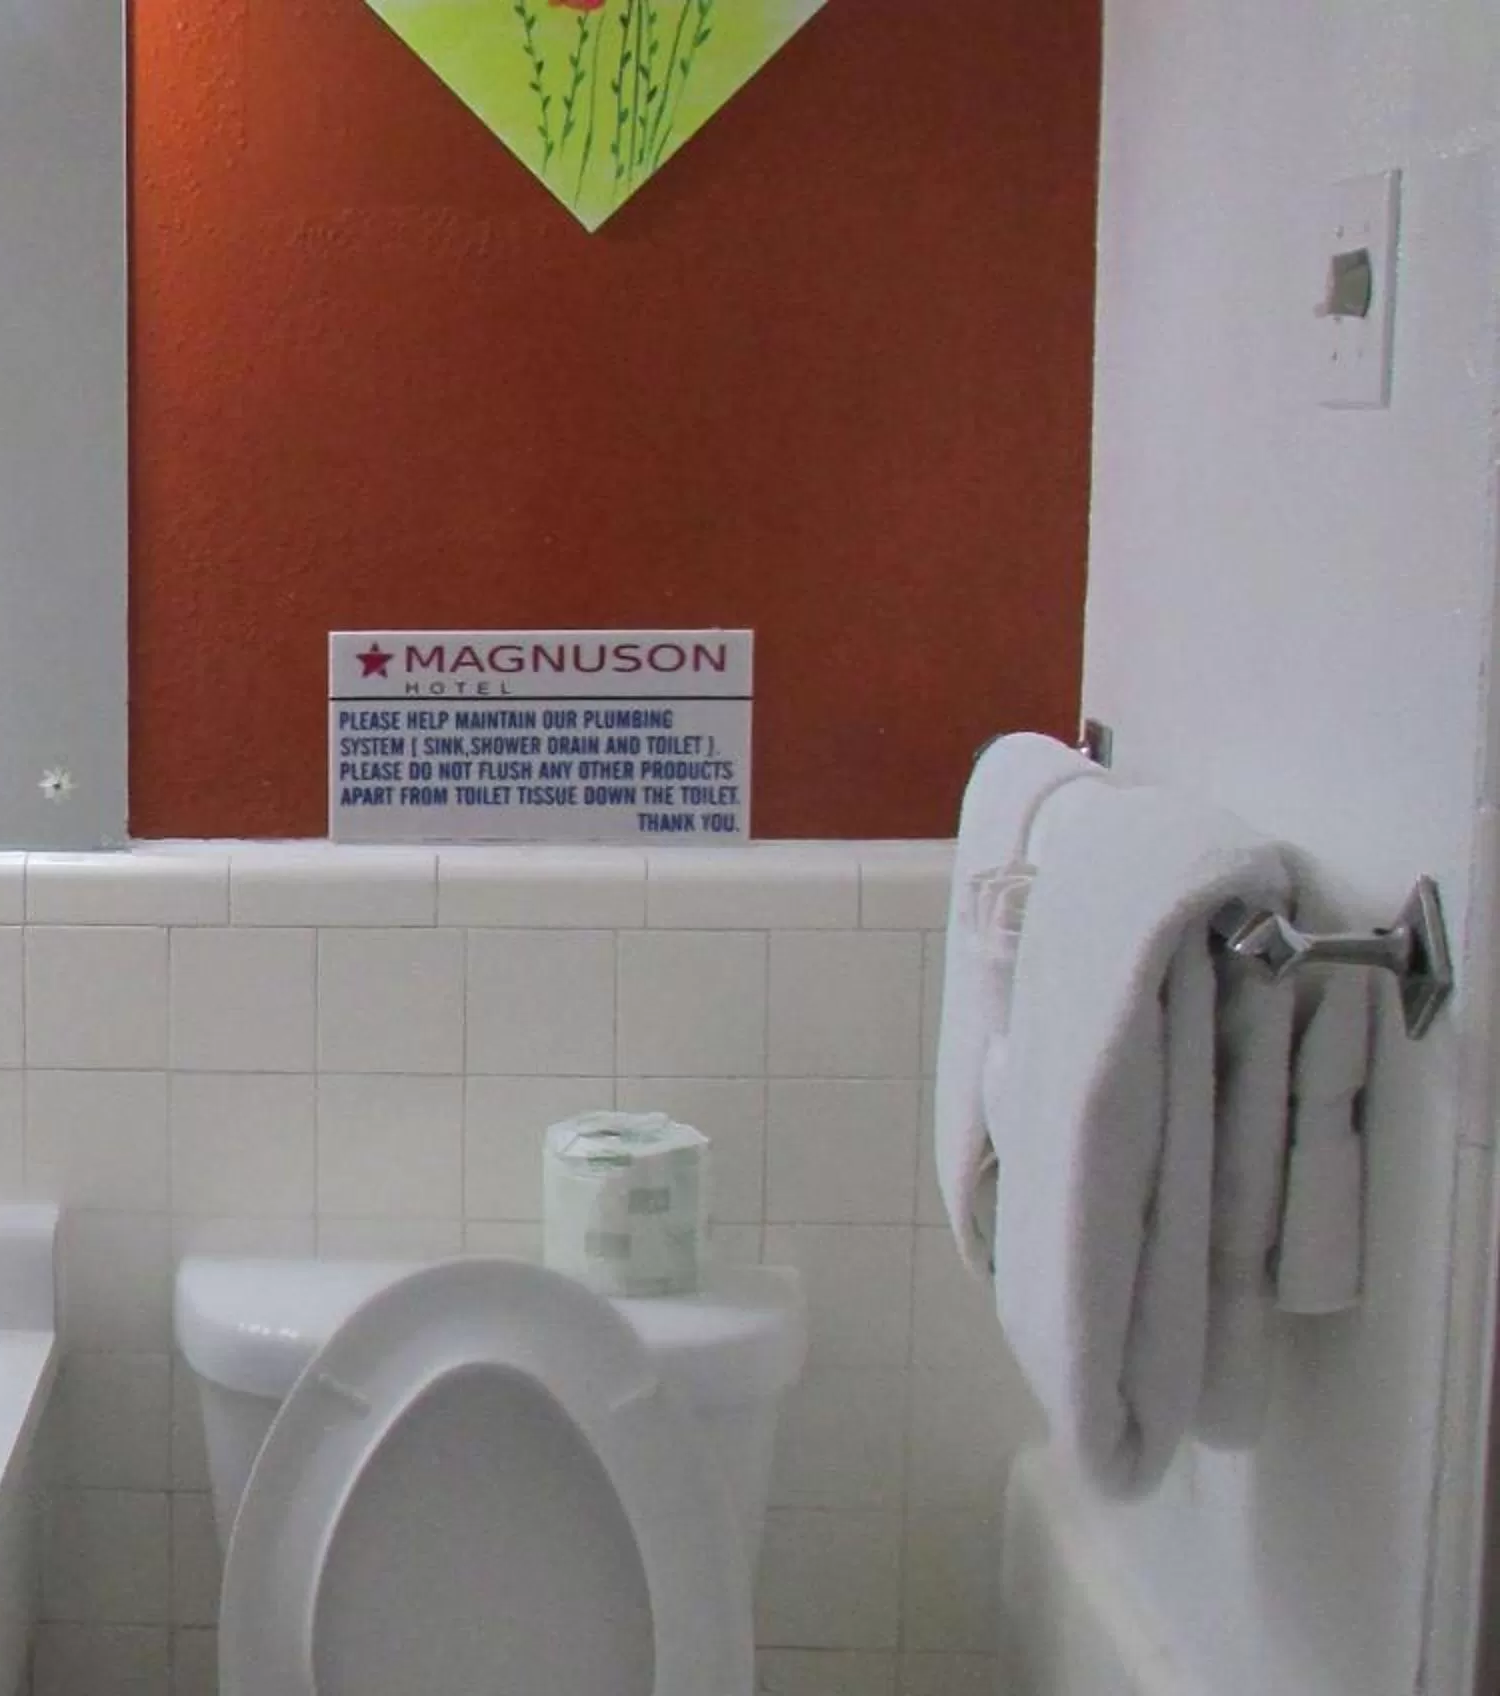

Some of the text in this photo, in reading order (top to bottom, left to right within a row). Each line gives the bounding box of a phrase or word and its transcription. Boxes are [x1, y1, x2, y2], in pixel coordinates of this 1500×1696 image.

[404, 642, 727, 673] MAGNUSON
[405, 681, 512, 695] HOTEL
[339, 709, 673, 730] PLEASE HELP MAINTAIN OUR PLUMBING
[340, 736, 404, 757] SYSTEM
[548, 736, 599, 755] DRAIN
[605, 736, 641, 755] AND
[645, 736, 703, 755] TOILET
[339, 761, 734, 781] PLEASE DO NOT FLUSH ANY OTHER PRODUCTS
[340, 786, 395, 806] APART
[401, 786, 448, 805] FROM
[455, 786, 511, 805] TOILET
[517, 786, 577, 805] TISSUE
[584, 786, 636, 805] DOWN
[642, 786, 674, 805] THE
[636, 813, 740, 832] THANK YOU.
